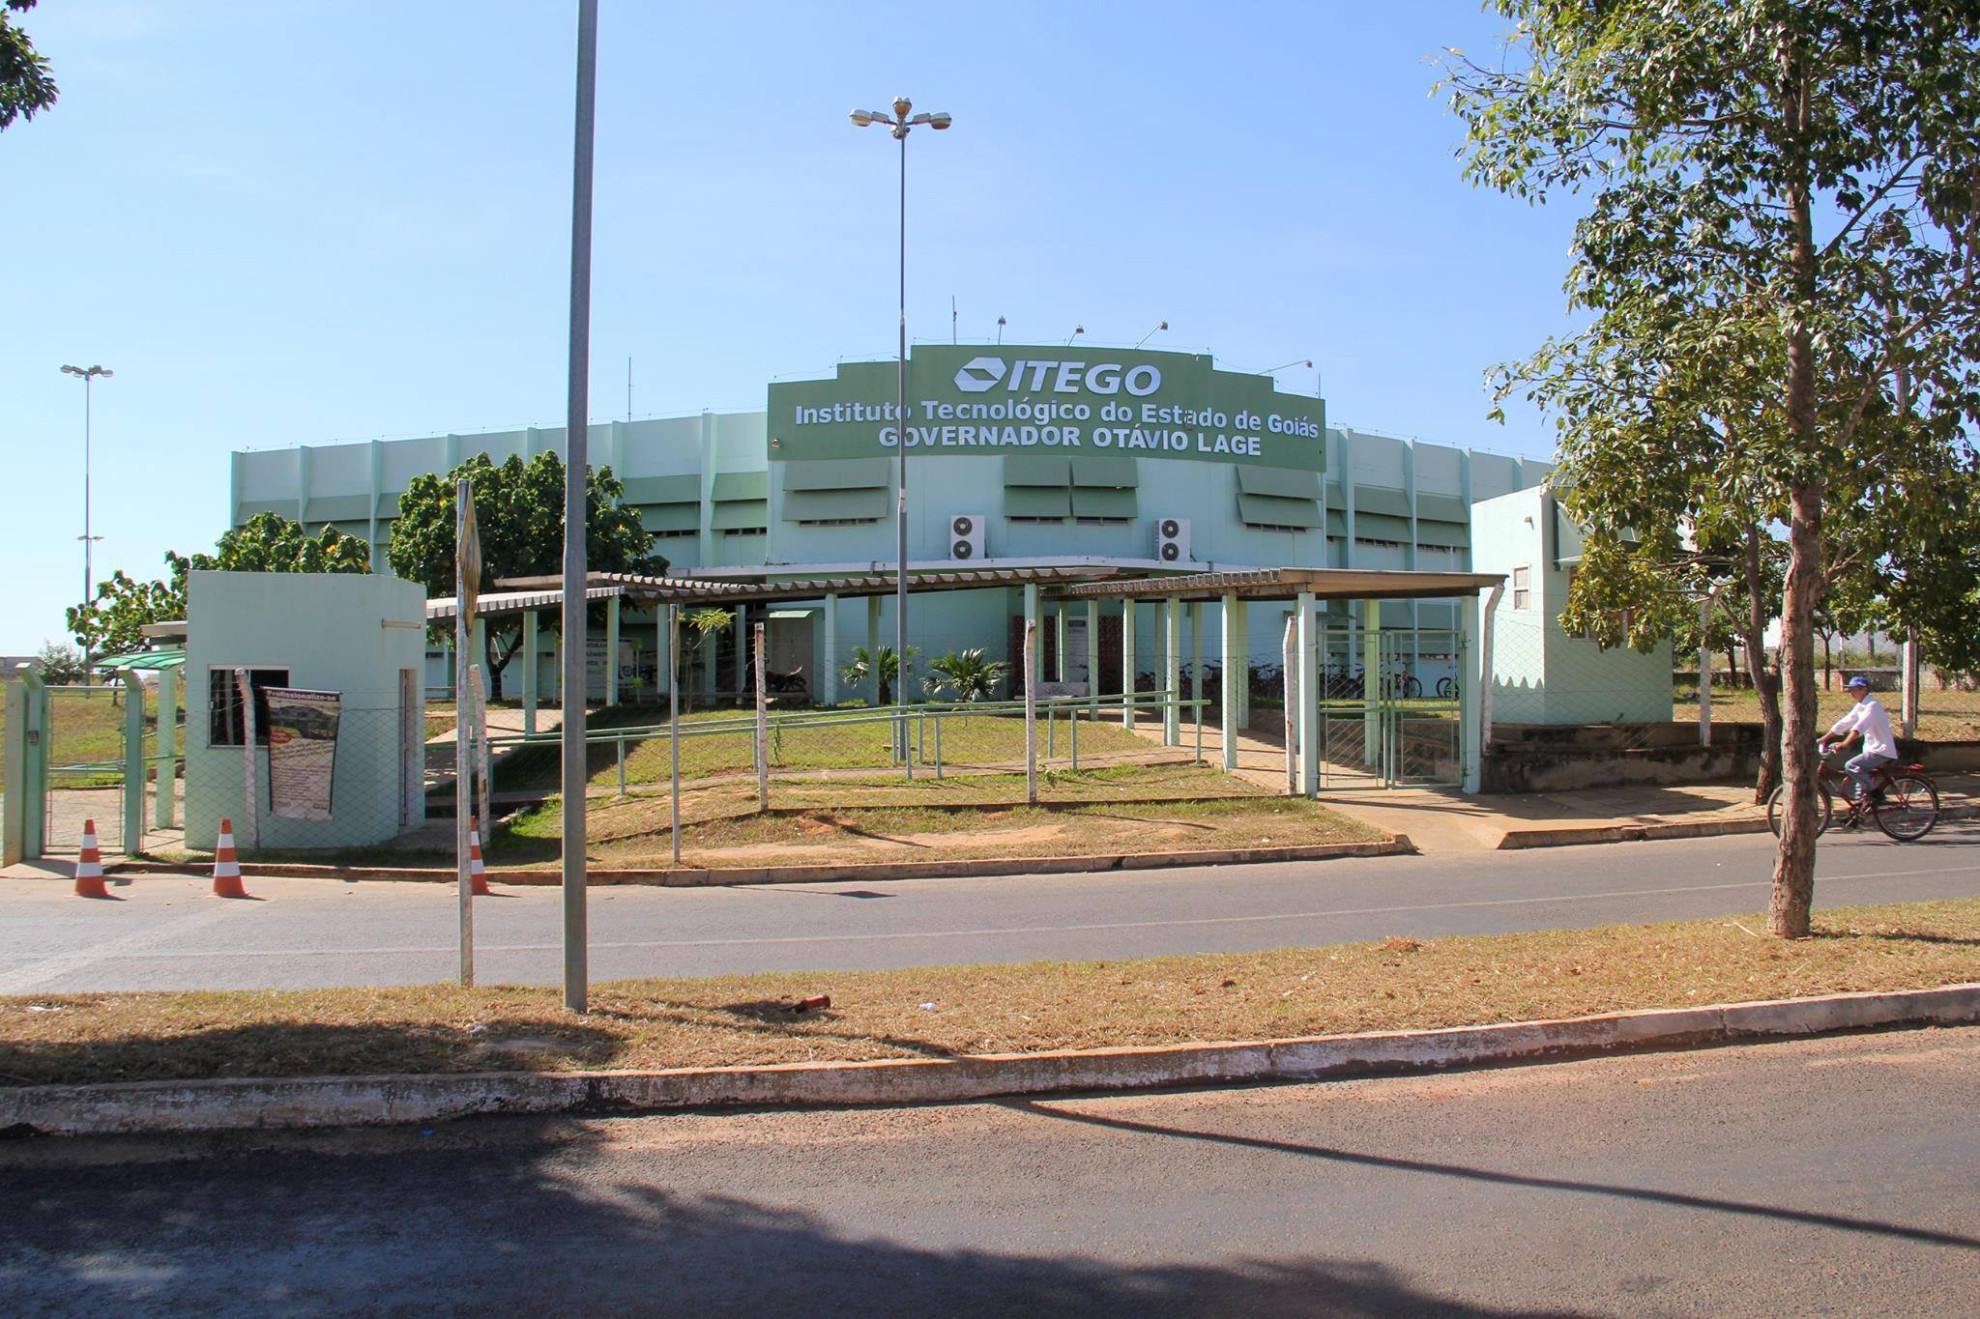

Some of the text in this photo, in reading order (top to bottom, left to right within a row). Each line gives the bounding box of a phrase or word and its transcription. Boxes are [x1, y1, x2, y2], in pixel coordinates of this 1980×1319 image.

[1008, 360, 1162, 396] ITEGO
[795, 397, 1319, 439] Instituto Tecnológico do Estado de Goiás
[879, 424, 1262, 456] GOVERNADOR OTÁVIO LAGE
